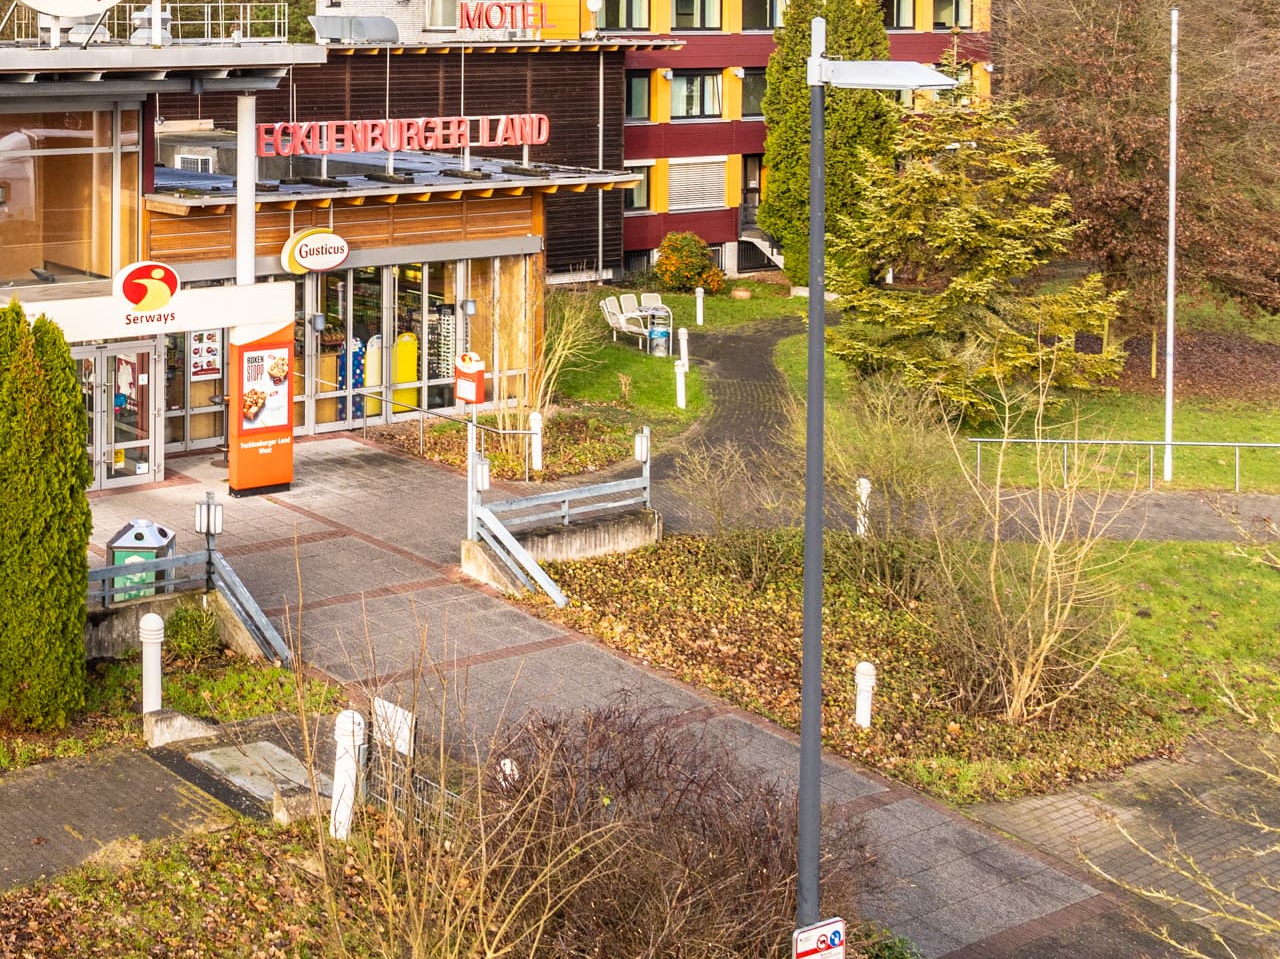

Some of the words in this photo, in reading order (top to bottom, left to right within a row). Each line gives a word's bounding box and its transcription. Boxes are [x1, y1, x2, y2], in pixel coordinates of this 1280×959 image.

[459, 2, 557, 29] MOTEL
[256, 117, 469, 158] ECKLENBURGER
[480, 113, 550, 147] LAND
[299, 243, 345, 259] Gusticus
[125, 312, 176, 325] Serways
